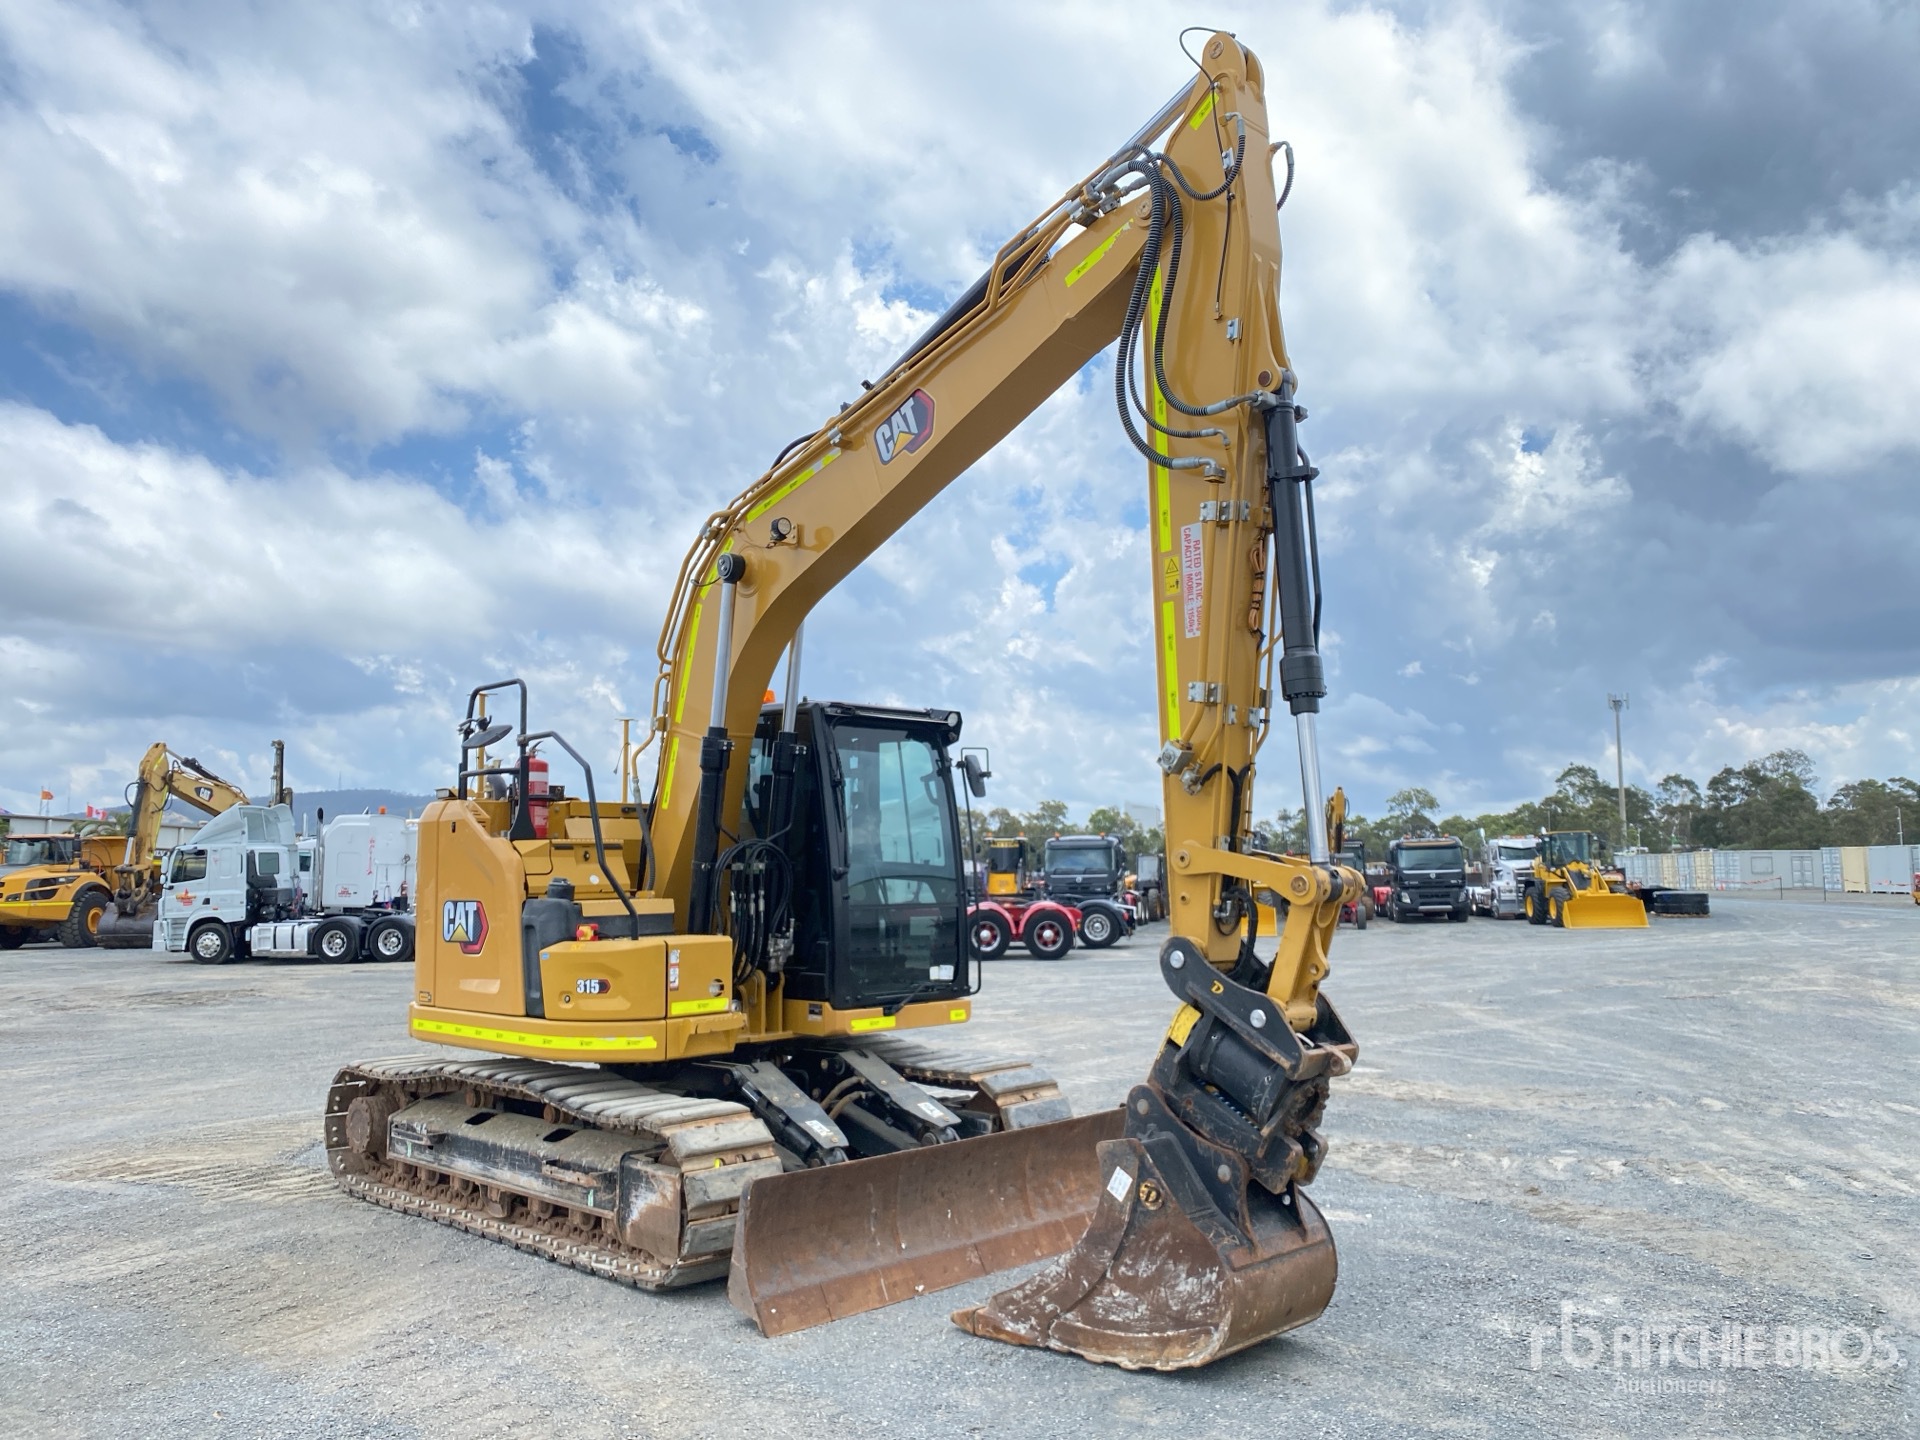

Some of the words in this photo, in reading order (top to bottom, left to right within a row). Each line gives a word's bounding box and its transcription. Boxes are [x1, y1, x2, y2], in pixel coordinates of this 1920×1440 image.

[874, 397, 919, 462] CAT
[1184, 527, 1193, 569] CAPACITY
[1193, 540, 1202, 568] RATED
[443, 901, 477, 942] CAT
[576, 978, 600, 994] 315
